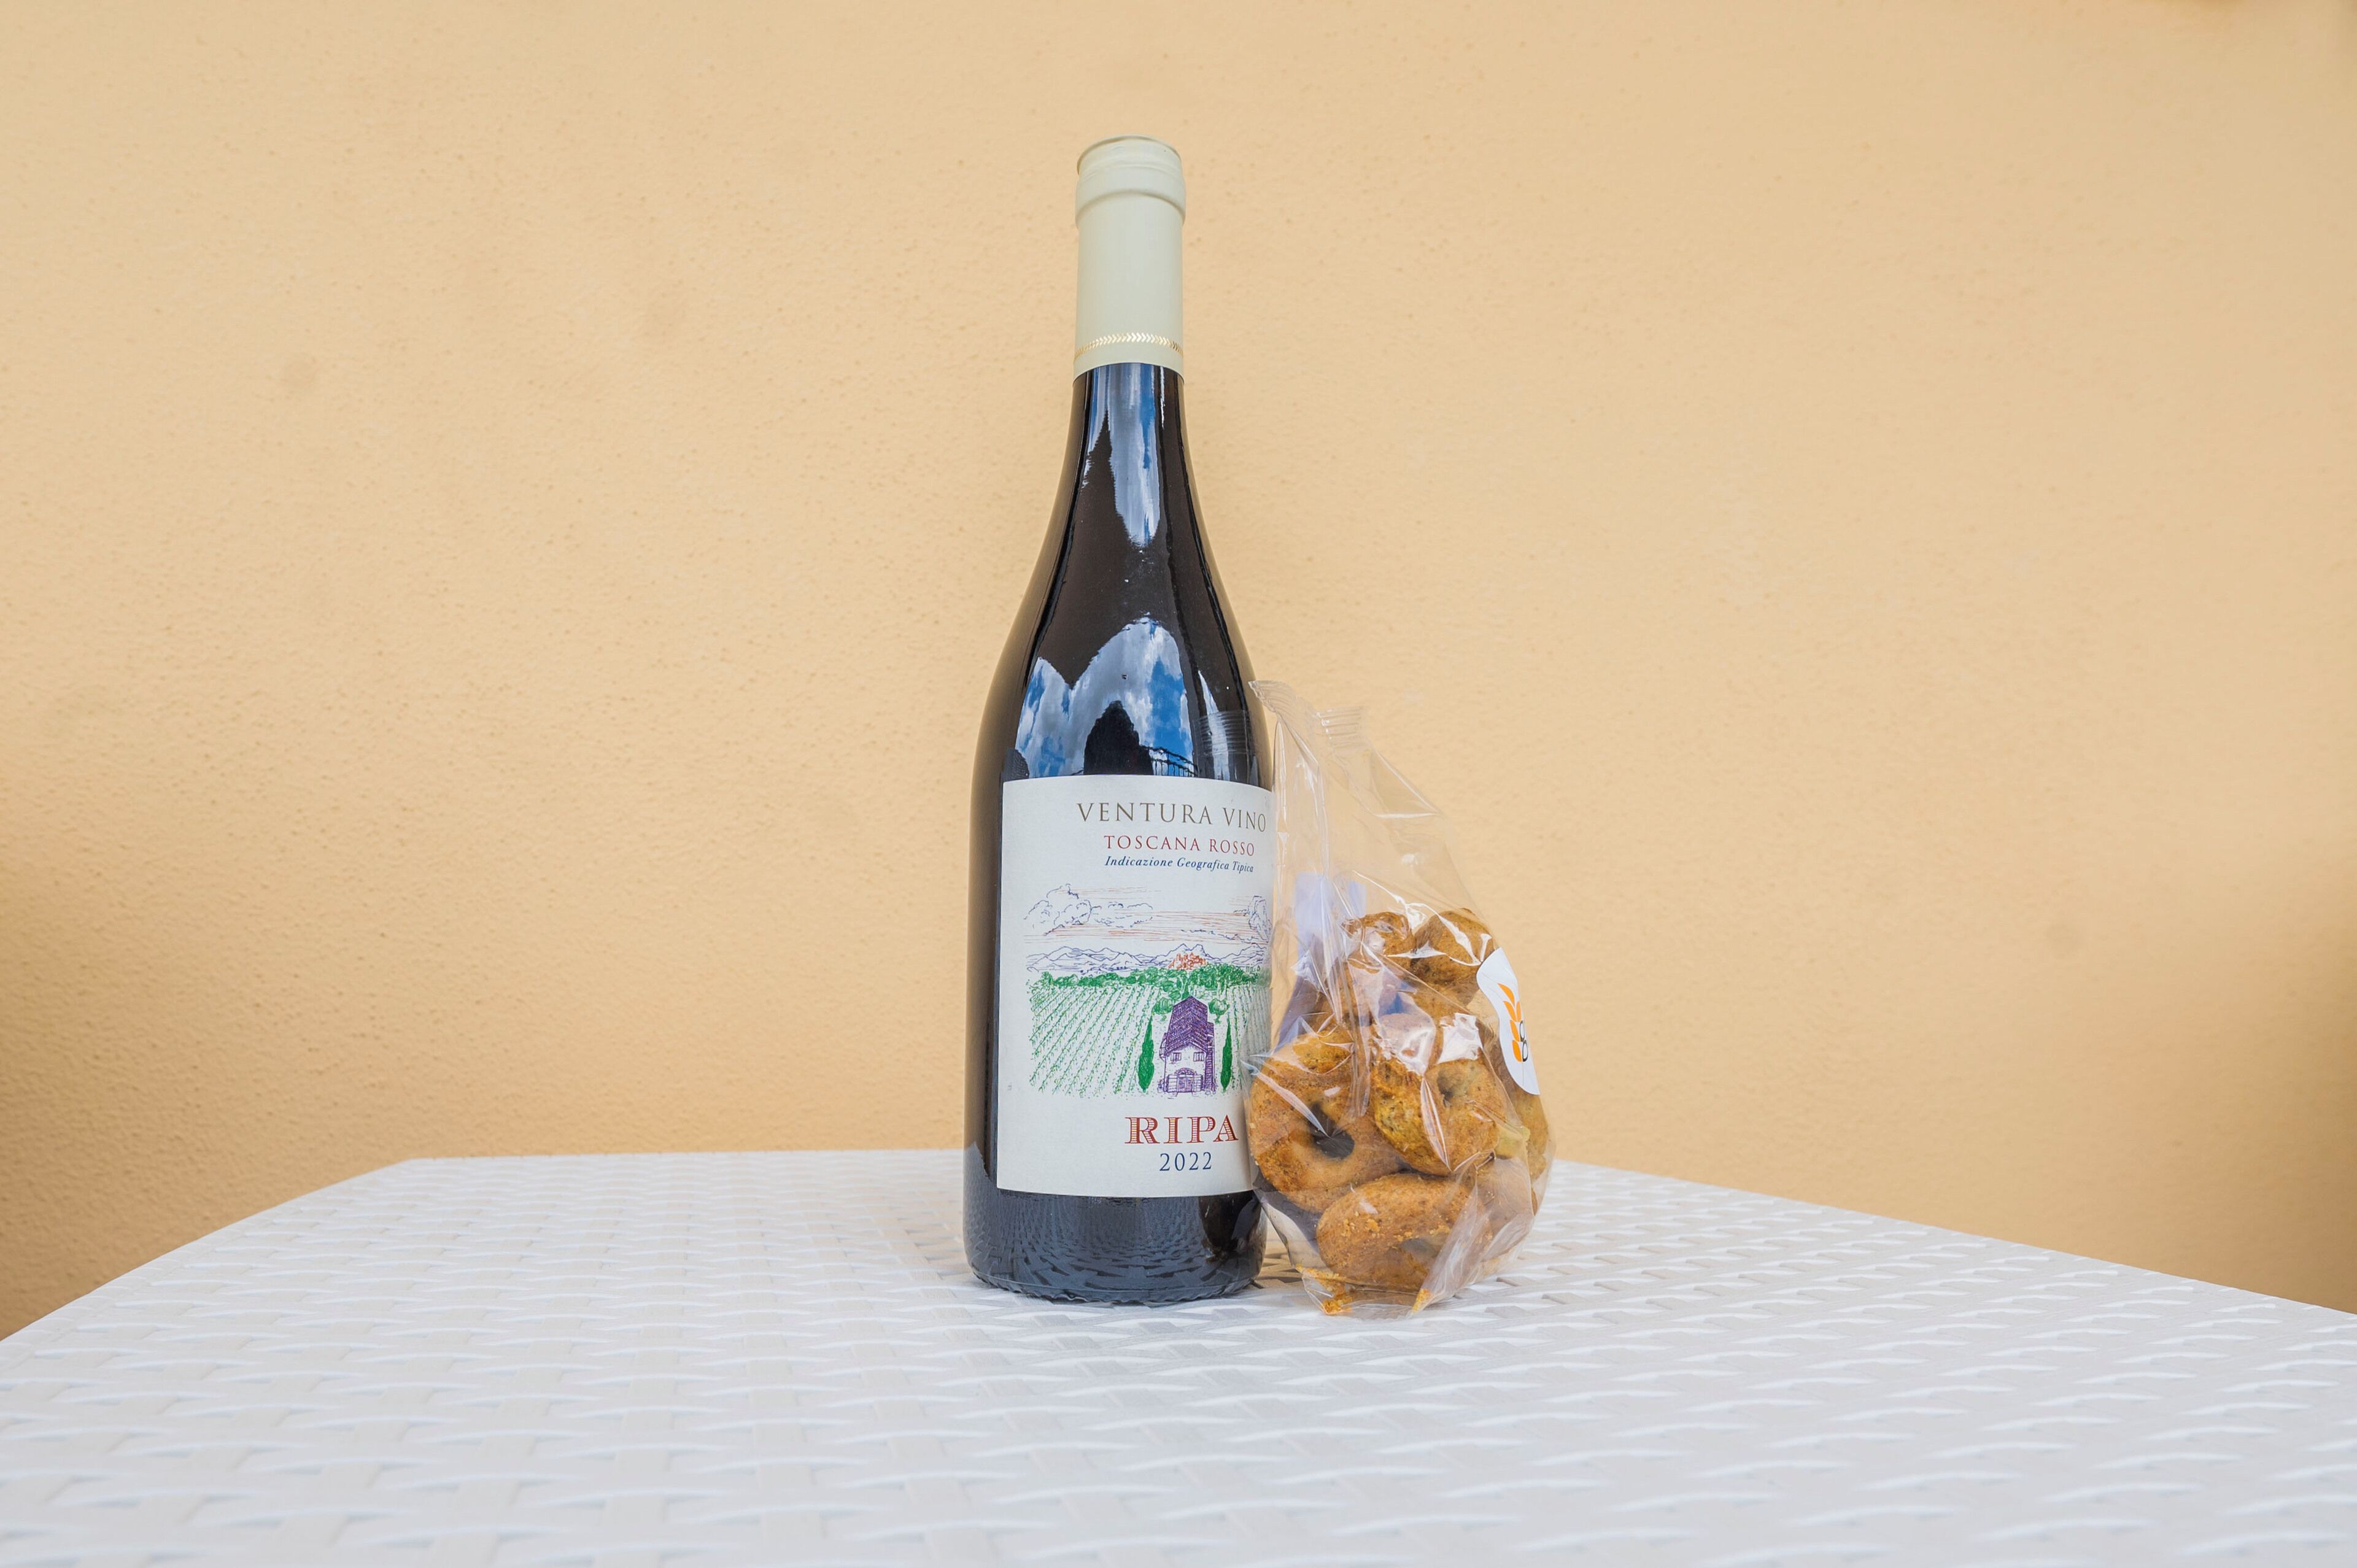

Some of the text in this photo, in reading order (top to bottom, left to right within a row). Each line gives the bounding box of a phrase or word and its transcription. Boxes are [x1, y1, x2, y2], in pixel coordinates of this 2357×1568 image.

[1077, 802, 1266, 832] VENTURA VINO
[1104, 835, 1255, 857] TOSCANA ROSSO
[1105, 855, 1254, 874] Indicazione Geografica Tipica
[1124, 1114, 1239, 1144] RIPA
[1159, 1151, 1212, 1172] 2022
